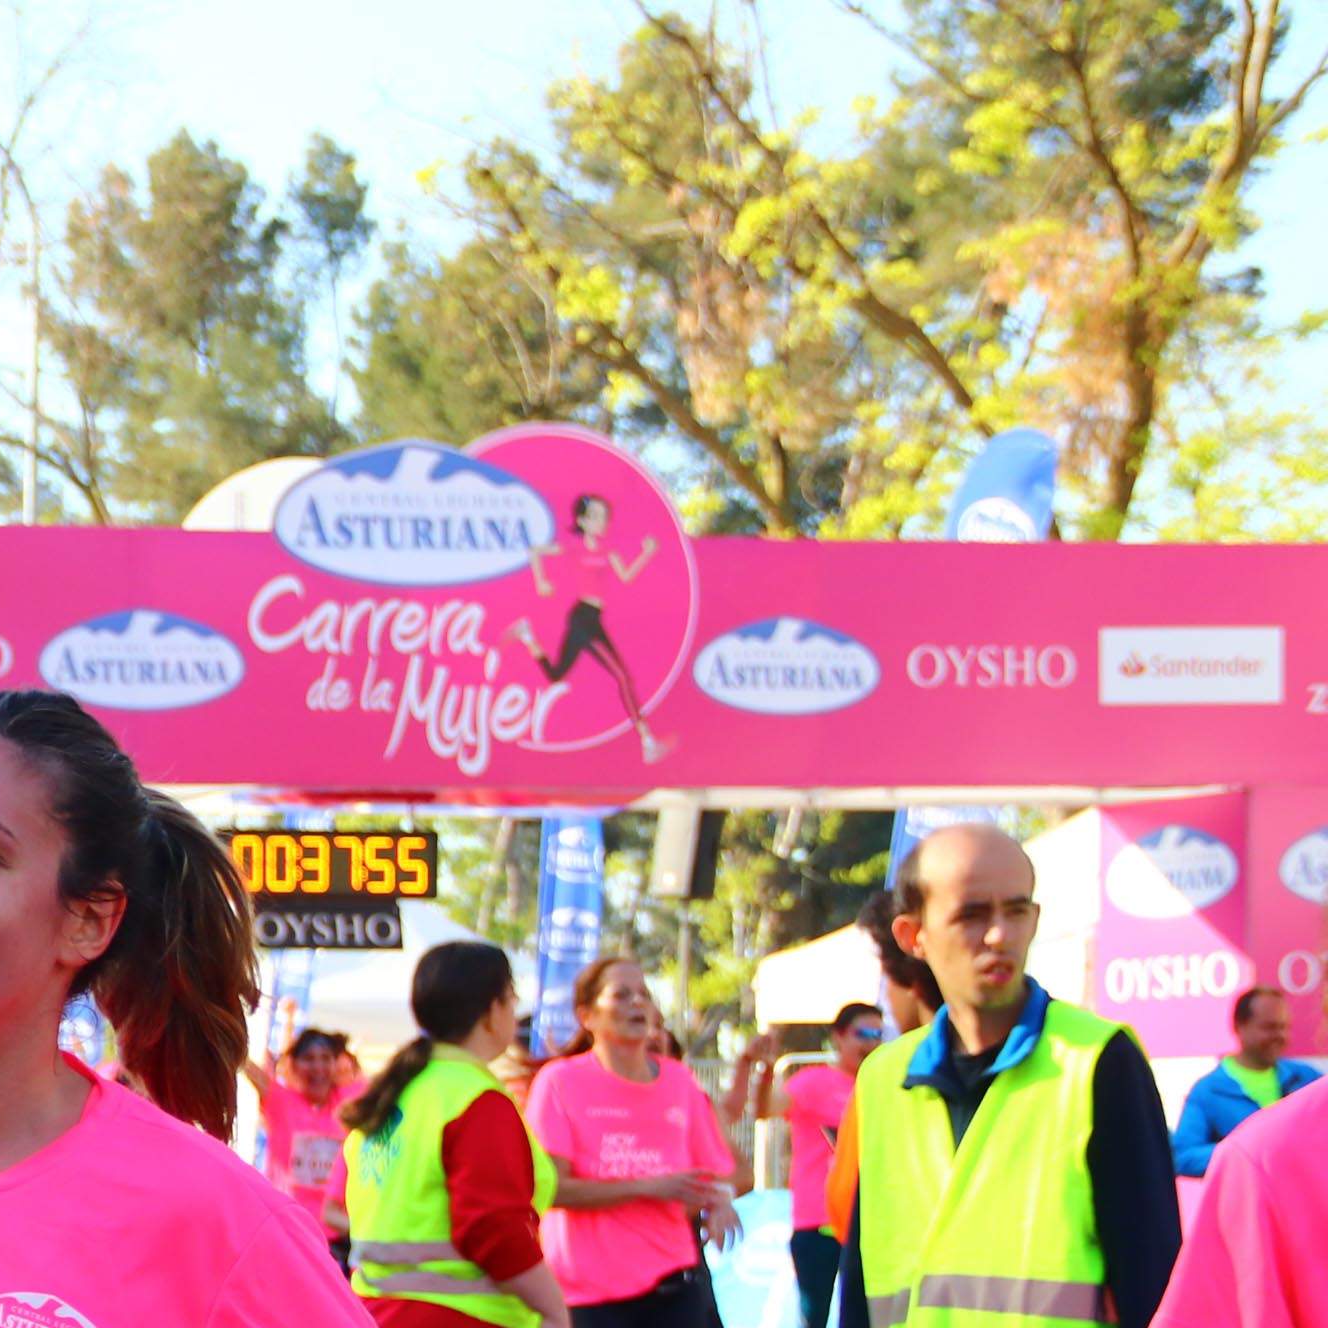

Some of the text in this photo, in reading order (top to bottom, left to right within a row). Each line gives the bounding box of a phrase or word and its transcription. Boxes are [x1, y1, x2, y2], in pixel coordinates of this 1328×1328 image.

[297, 493, 532, 551] ASTURIANA
[248, 575, 486, 657] Carrera
[55, 645, 228, 685] ASTURIANA
[706, 652, 863, 690] ASTURIANA
[907, 644, 1077, 688] OYSHO
[1150, 655, 1264, 679] Santander
[306, 648, 572, 777] de la Mujer
[256, 911, 399, 946] OYSHO
[1104, 950, 1241, 1004] OYSHO
